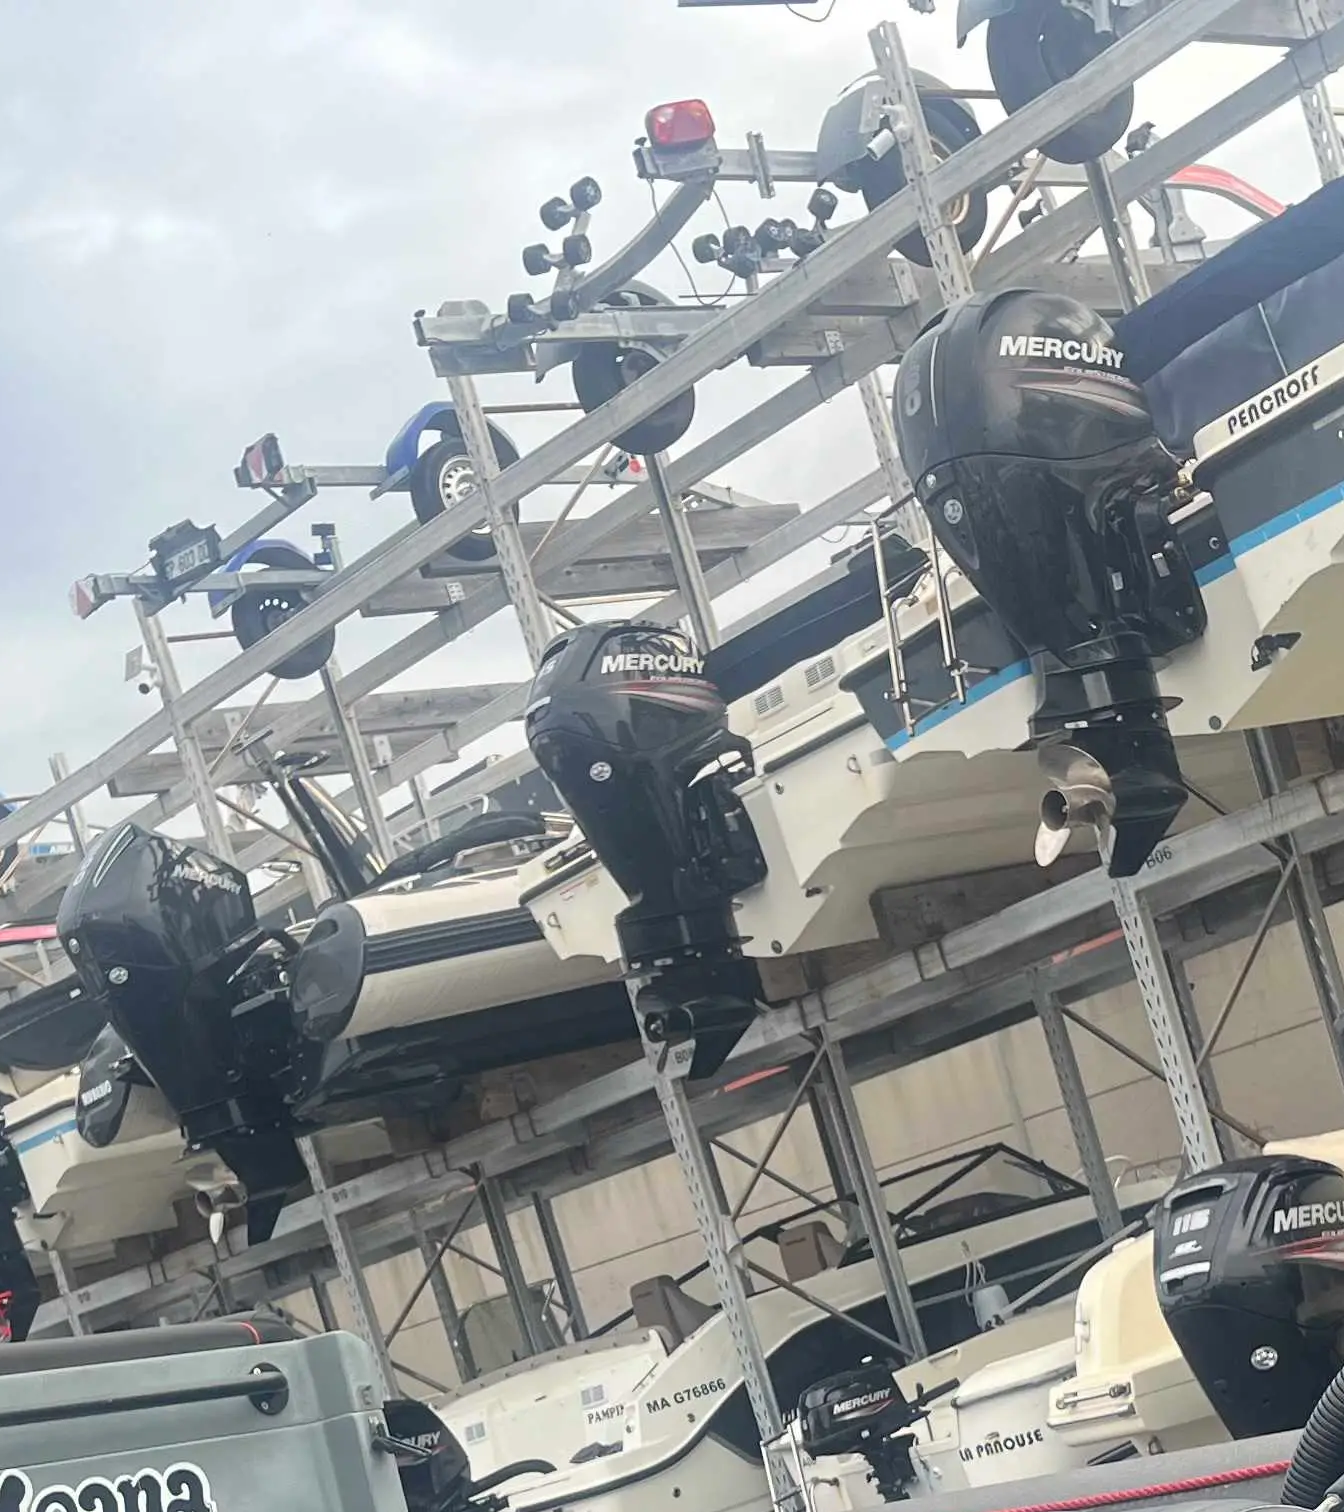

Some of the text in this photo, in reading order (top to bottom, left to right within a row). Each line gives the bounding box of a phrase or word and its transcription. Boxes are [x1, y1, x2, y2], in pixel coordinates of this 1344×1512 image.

[999, 335, 1125, 369] MERCURY
[1226, 365, 1320, 436] PENCROFF
[600, 653, 705, 675] MERCURY
[1171, 1208, 1211, 1237] 115
[646, 1377, 727, 1414] MA G76866
[832, 1387, 892, 1416] MERCURY
[975, 1428, 1044, 1459] PANOUSE
